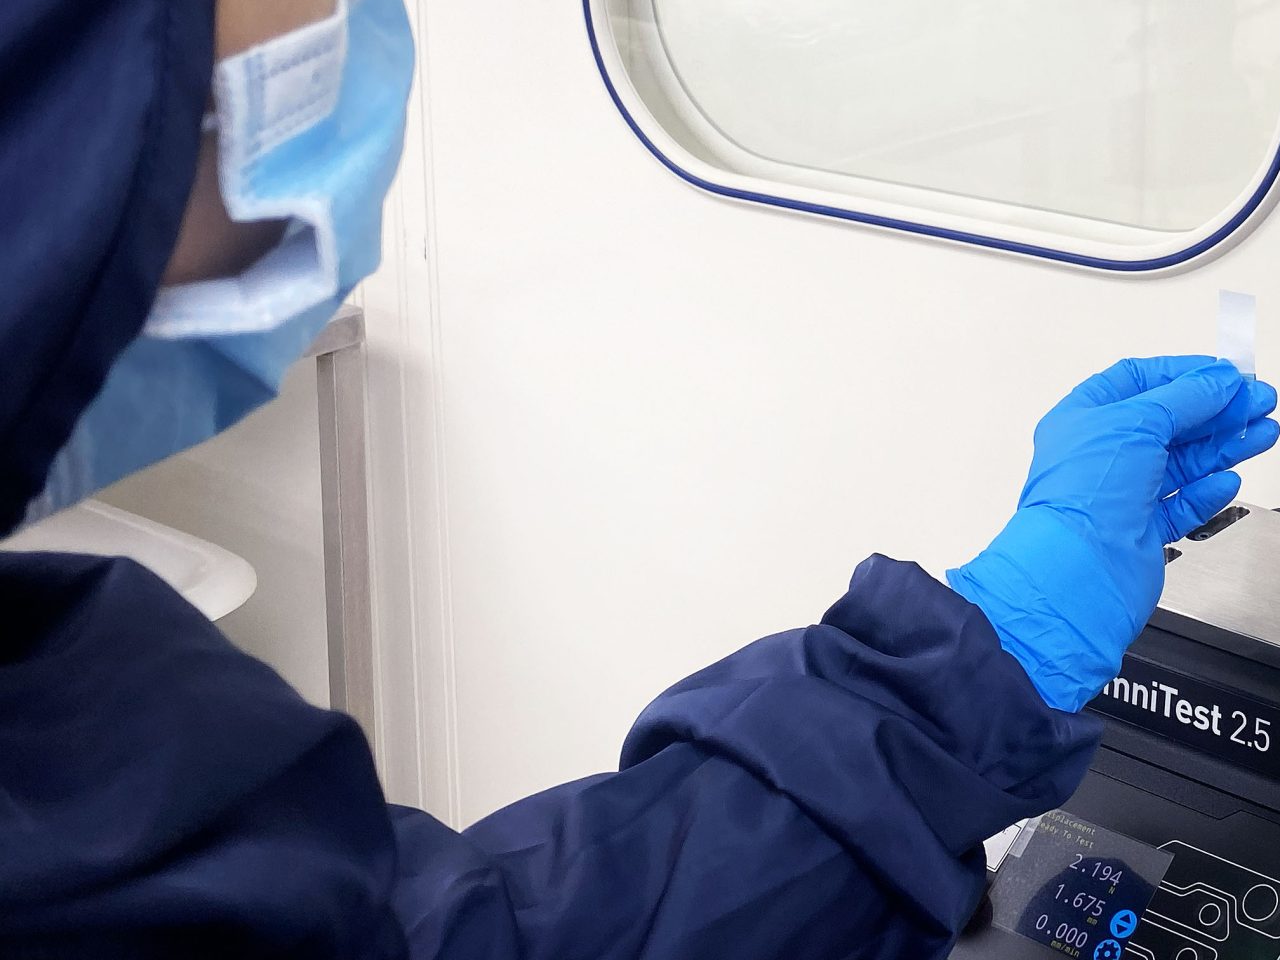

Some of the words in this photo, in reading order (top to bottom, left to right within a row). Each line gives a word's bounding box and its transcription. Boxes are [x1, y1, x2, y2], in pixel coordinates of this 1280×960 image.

[1103, 676, 1222, 735] mniTest
[1230, 710, 1271, 751] 2.5
[1040, 822, 1058, 834] eady
[1063, 830, 1072, 839] To
[1077, 835, 1094, 849] Test
[1069, 853, 1123, 886] 2.194
[1055, 883, 1106, 916] 1.675
[1035, 914, 1088, 948] 0.000
